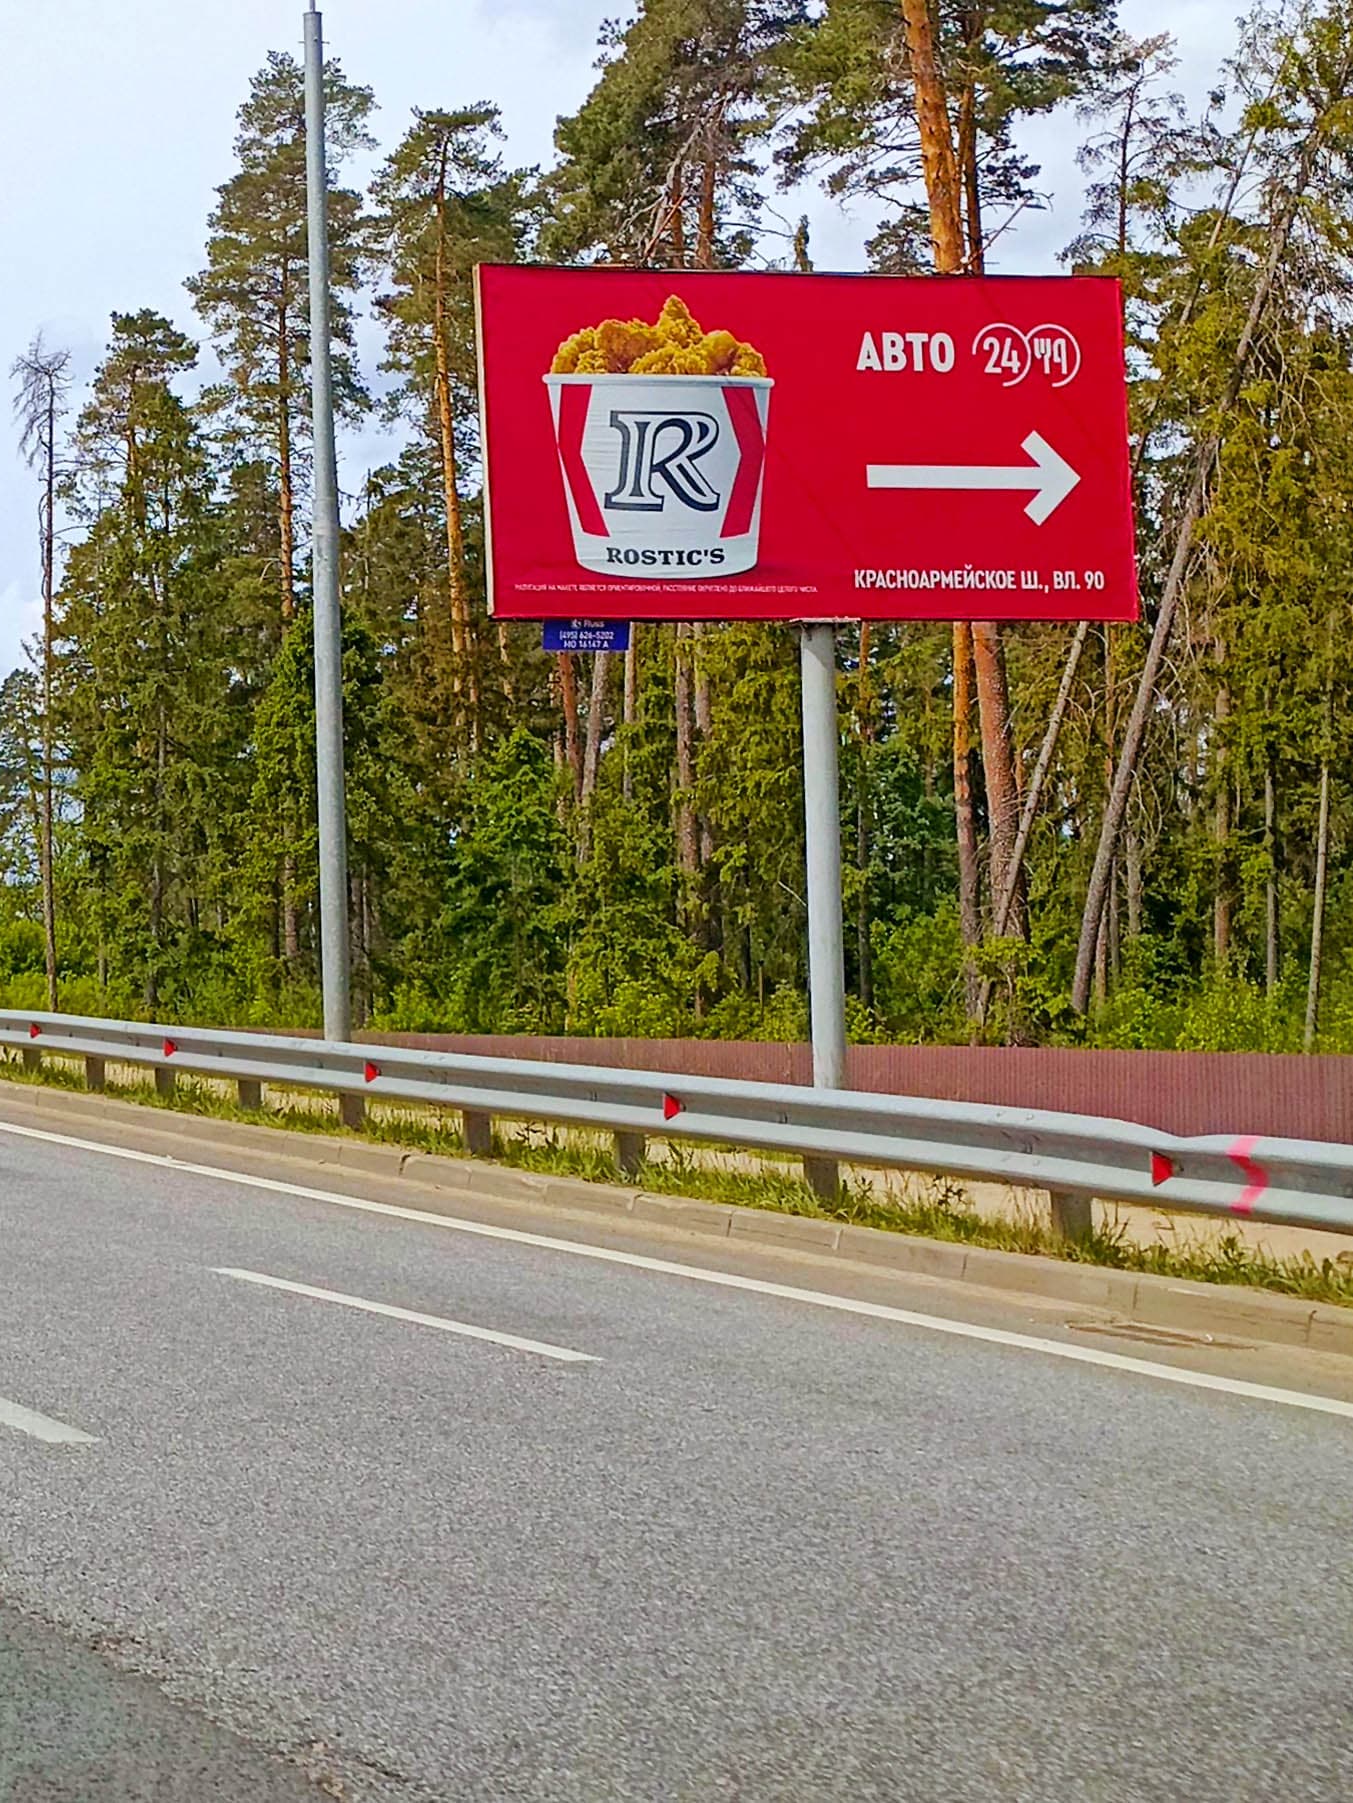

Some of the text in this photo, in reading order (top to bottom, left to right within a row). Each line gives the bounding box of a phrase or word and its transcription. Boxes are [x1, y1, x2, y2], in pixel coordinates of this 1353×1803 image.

[856, 331, 1021, 374] АВТО 24
[604, 410, 721, 512] R
[605, 547, 726, 566] ROSTIC'S
[854, 564, 1105, 594] КРАСНОАРМЕЙСКОЕ Ш., ВЛ. 90
